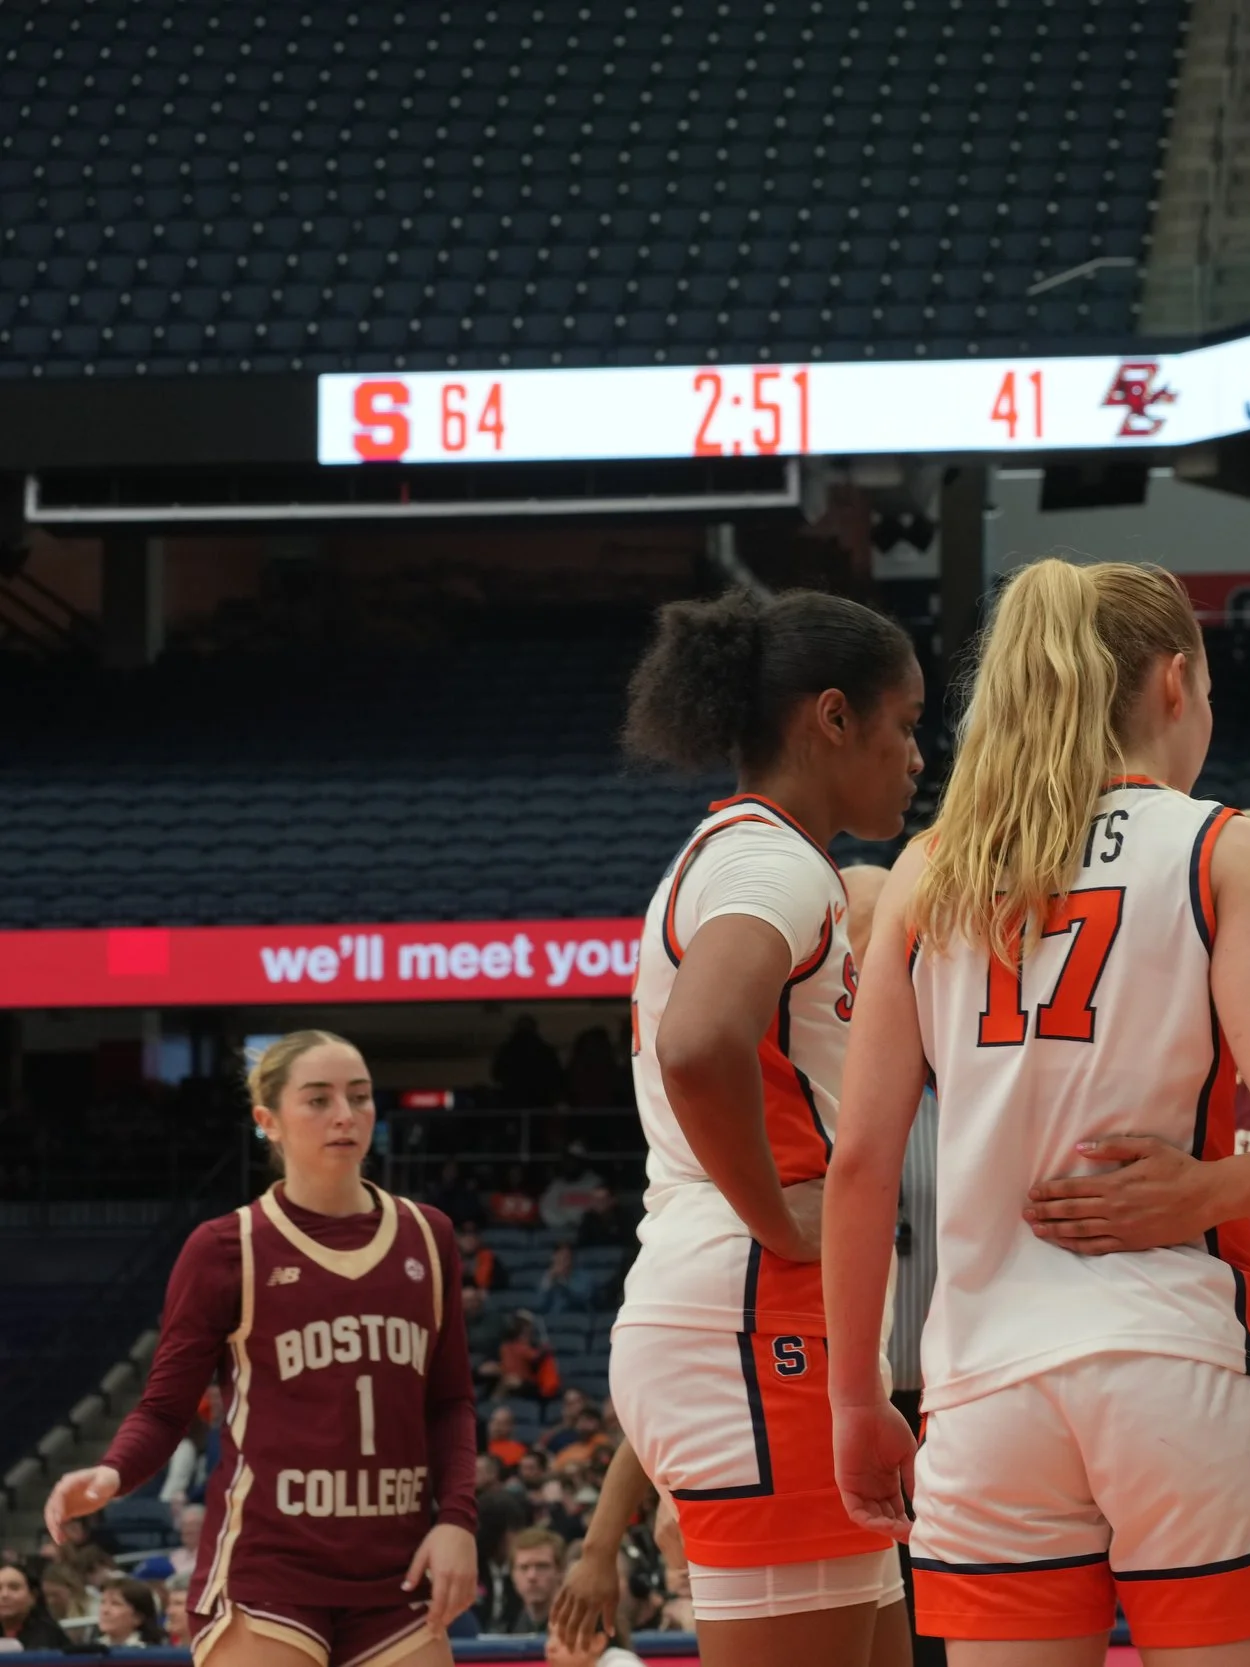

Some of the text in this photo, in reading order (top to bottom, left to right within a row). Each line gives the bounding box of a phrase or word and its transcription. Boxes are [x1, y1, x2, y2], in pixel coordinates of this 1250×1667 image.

[353, 380, 410, 461] S
[441, 382, 505, 453] 64
[692, 365, 811, 458] 2:51
[990, 370, 1043, 439] 41
[261, 934, 384, 983] we'll
[398, 933, 534, 980] meet
[977, 886, 1127, 1048] 17
[275, 1314, 429, 1382] BOSTON
[772, 1335, 808, 1377] S
[355, 1374, 376, 1456] 1
[276, 1465, 429, 1518] COLLEGE
